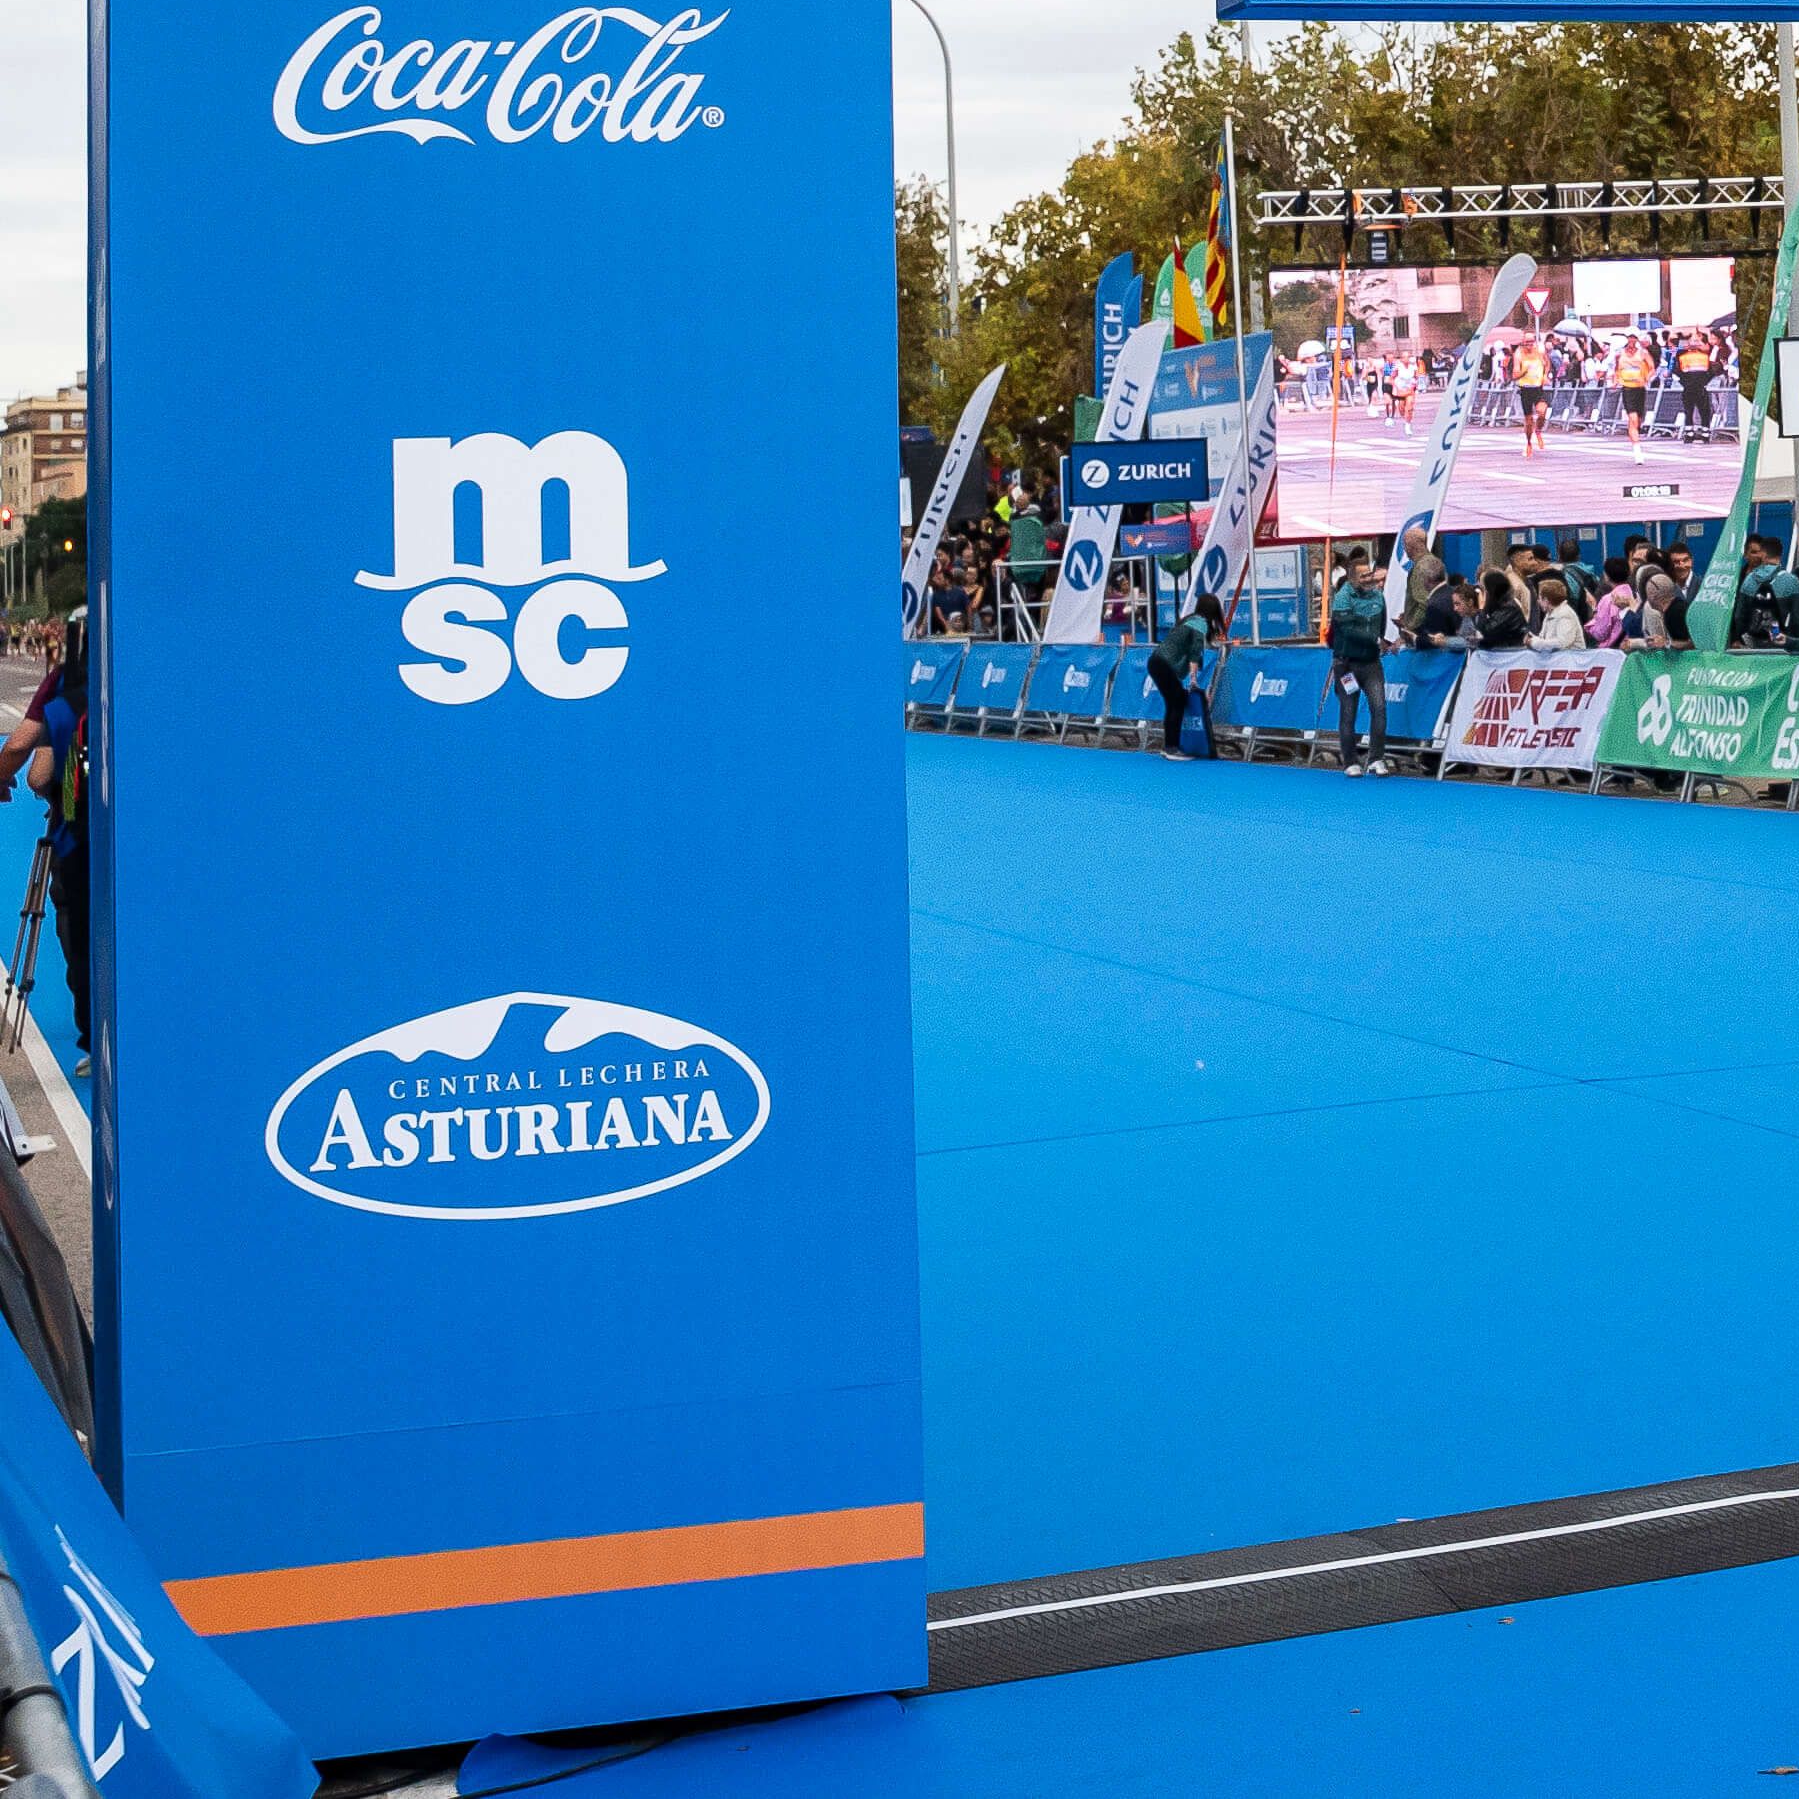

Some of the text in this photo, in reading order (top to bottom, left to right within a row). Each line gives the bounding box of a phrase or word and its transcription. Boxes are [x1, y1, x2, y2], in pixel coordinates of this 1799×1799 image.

[272, 5, 731, 145] Coca-Cola
[1117, 461, 1192, 481] ZURICH
[1675, 694, 1750, 728] TRINIDAD
[1669, 728, 1742, 763] ALFONSO
[388, 1060, 711, 1099] CENTRAL LECHERA
[309, 1088, 734, 1173] ASTURIANA
